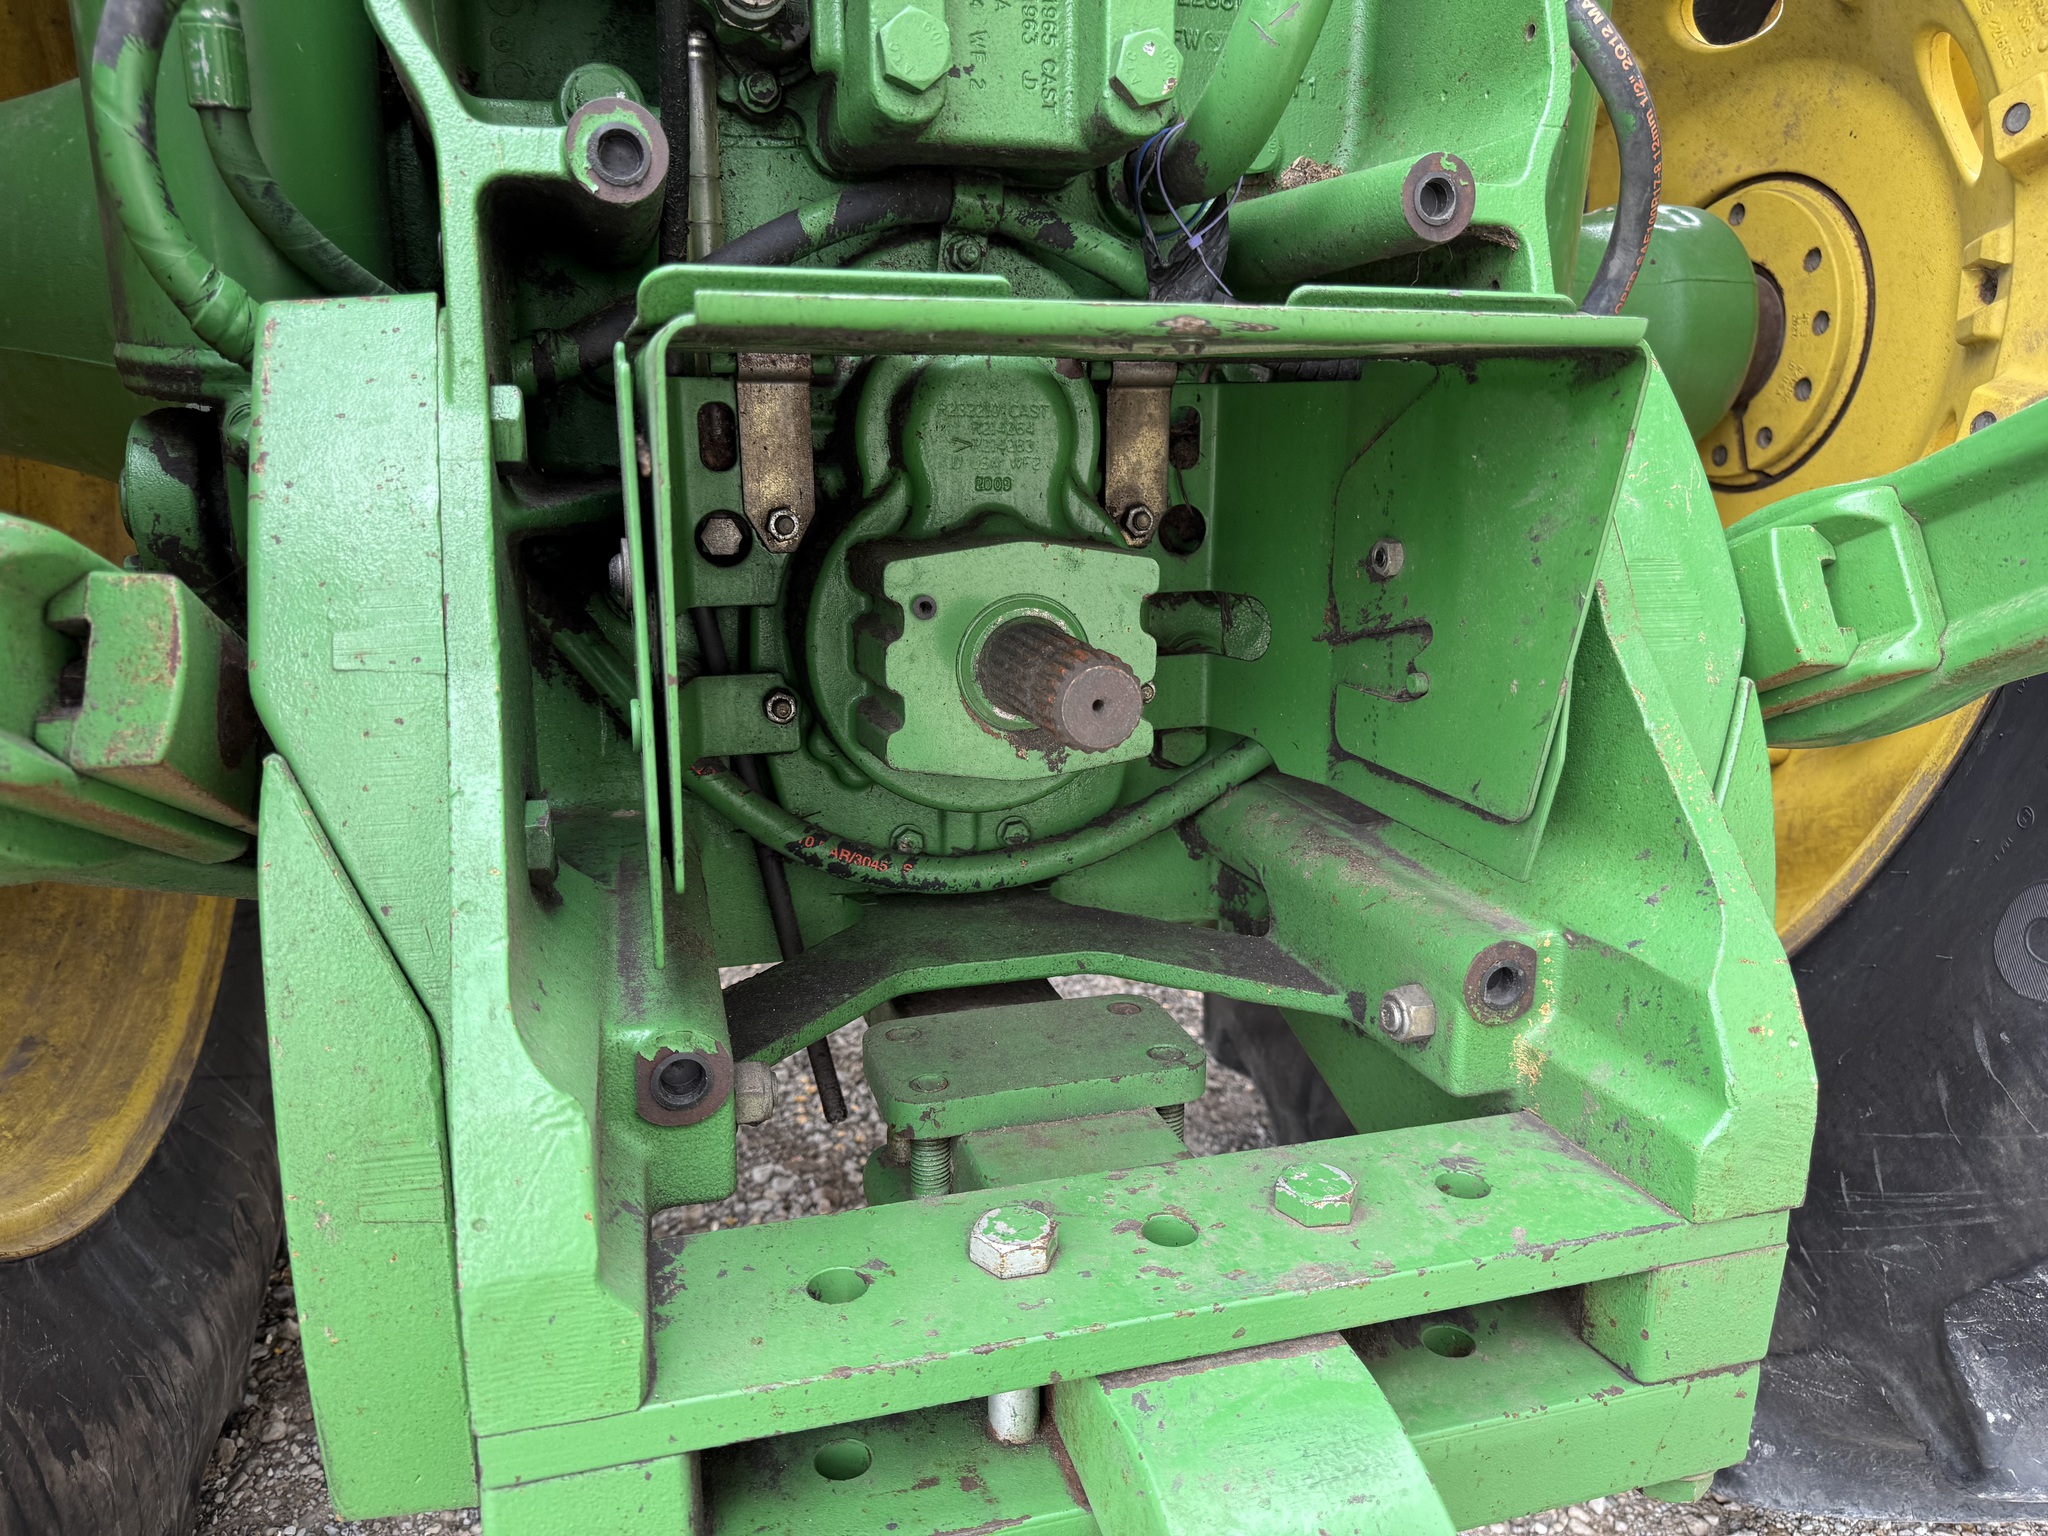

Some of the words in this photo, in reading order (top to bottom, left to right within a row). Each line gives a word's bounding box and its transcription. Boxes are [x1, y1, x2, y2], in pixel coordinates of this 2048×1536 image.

[1601, 24, 1634, 71] 2Q12
[1040, 58, 1058, 115] CAST
[1645, 108, 1661, 161] 12mm
[1008, 403, 1050, 418] CAST
[974, 475, 1012, 491] 2009
[817, 840, 889, 872] AR/3045
